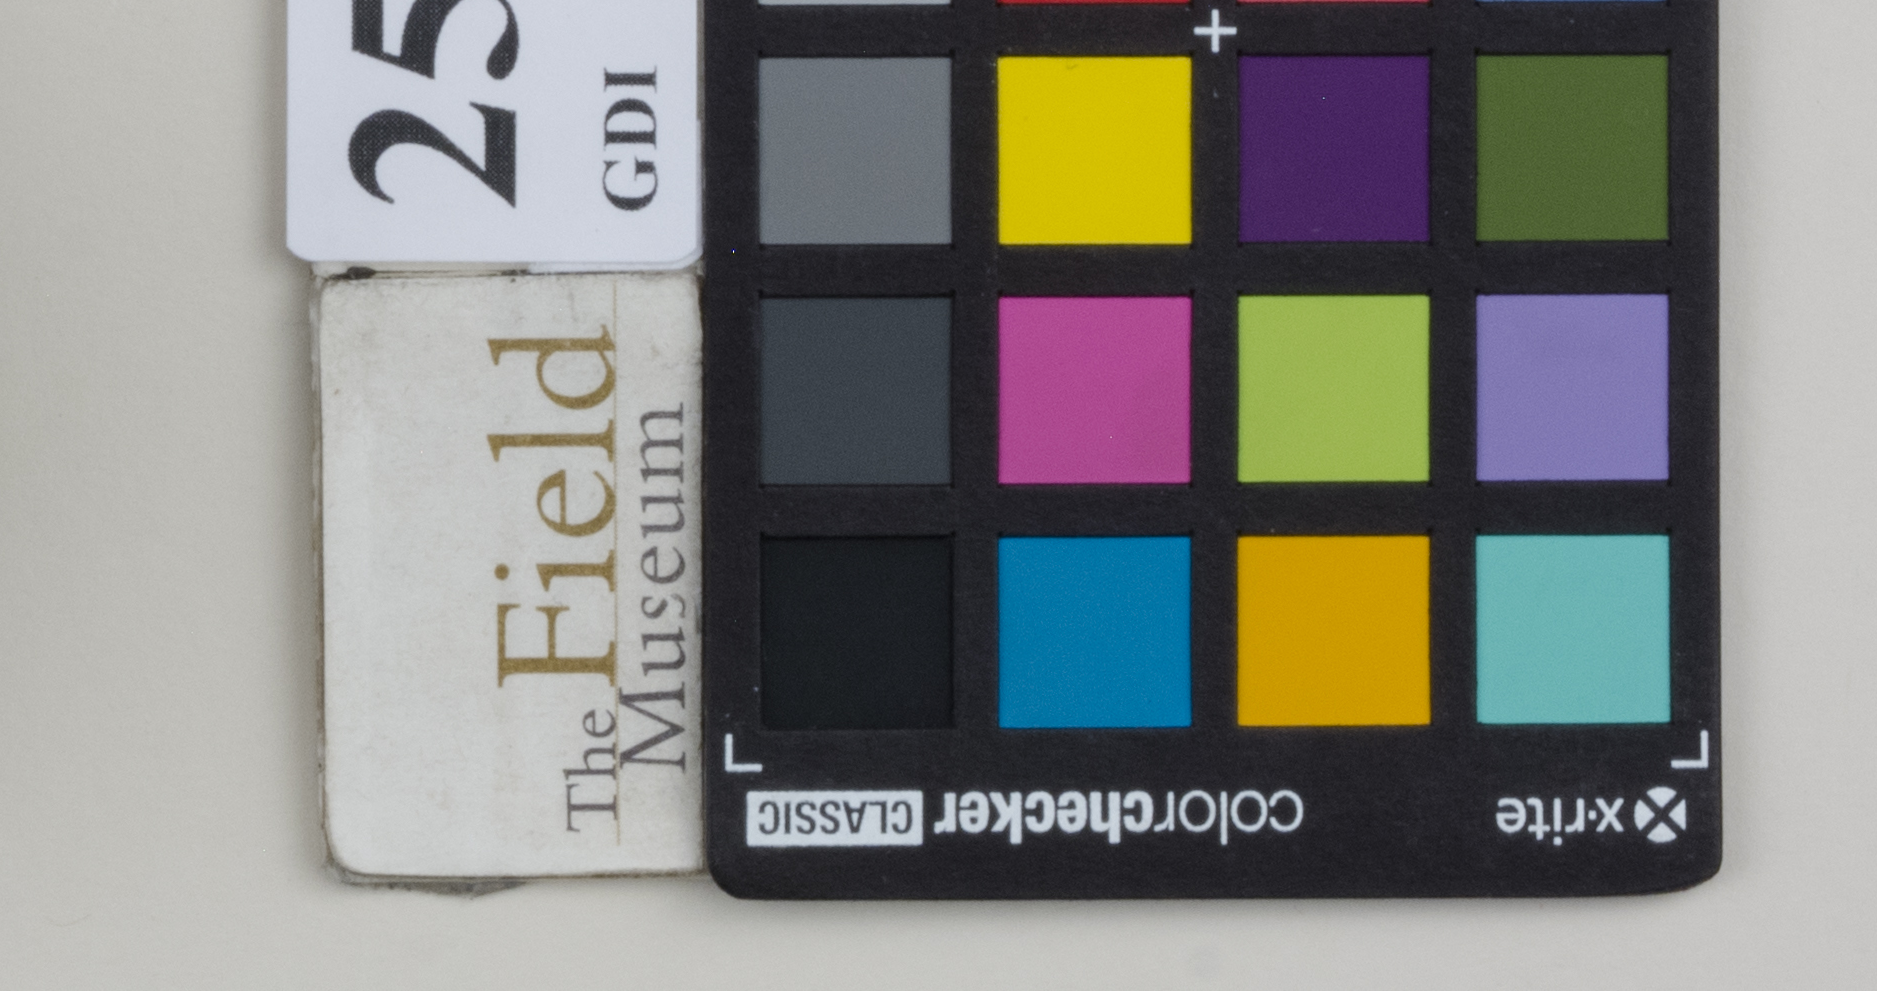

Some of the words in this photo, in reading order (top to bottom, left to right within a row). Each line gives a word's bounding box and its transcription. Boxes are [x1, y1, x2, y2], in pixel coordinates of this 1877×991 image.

[603, 66, 659, 211] GDI
[486, 324, 617, 688] Field
[618, 401, 687, 773] Museum
[562, 708, 619, 833] The
[758, 800, 914, 835] CLASSIC
[933, 789, 1305, 846] colorchecker
